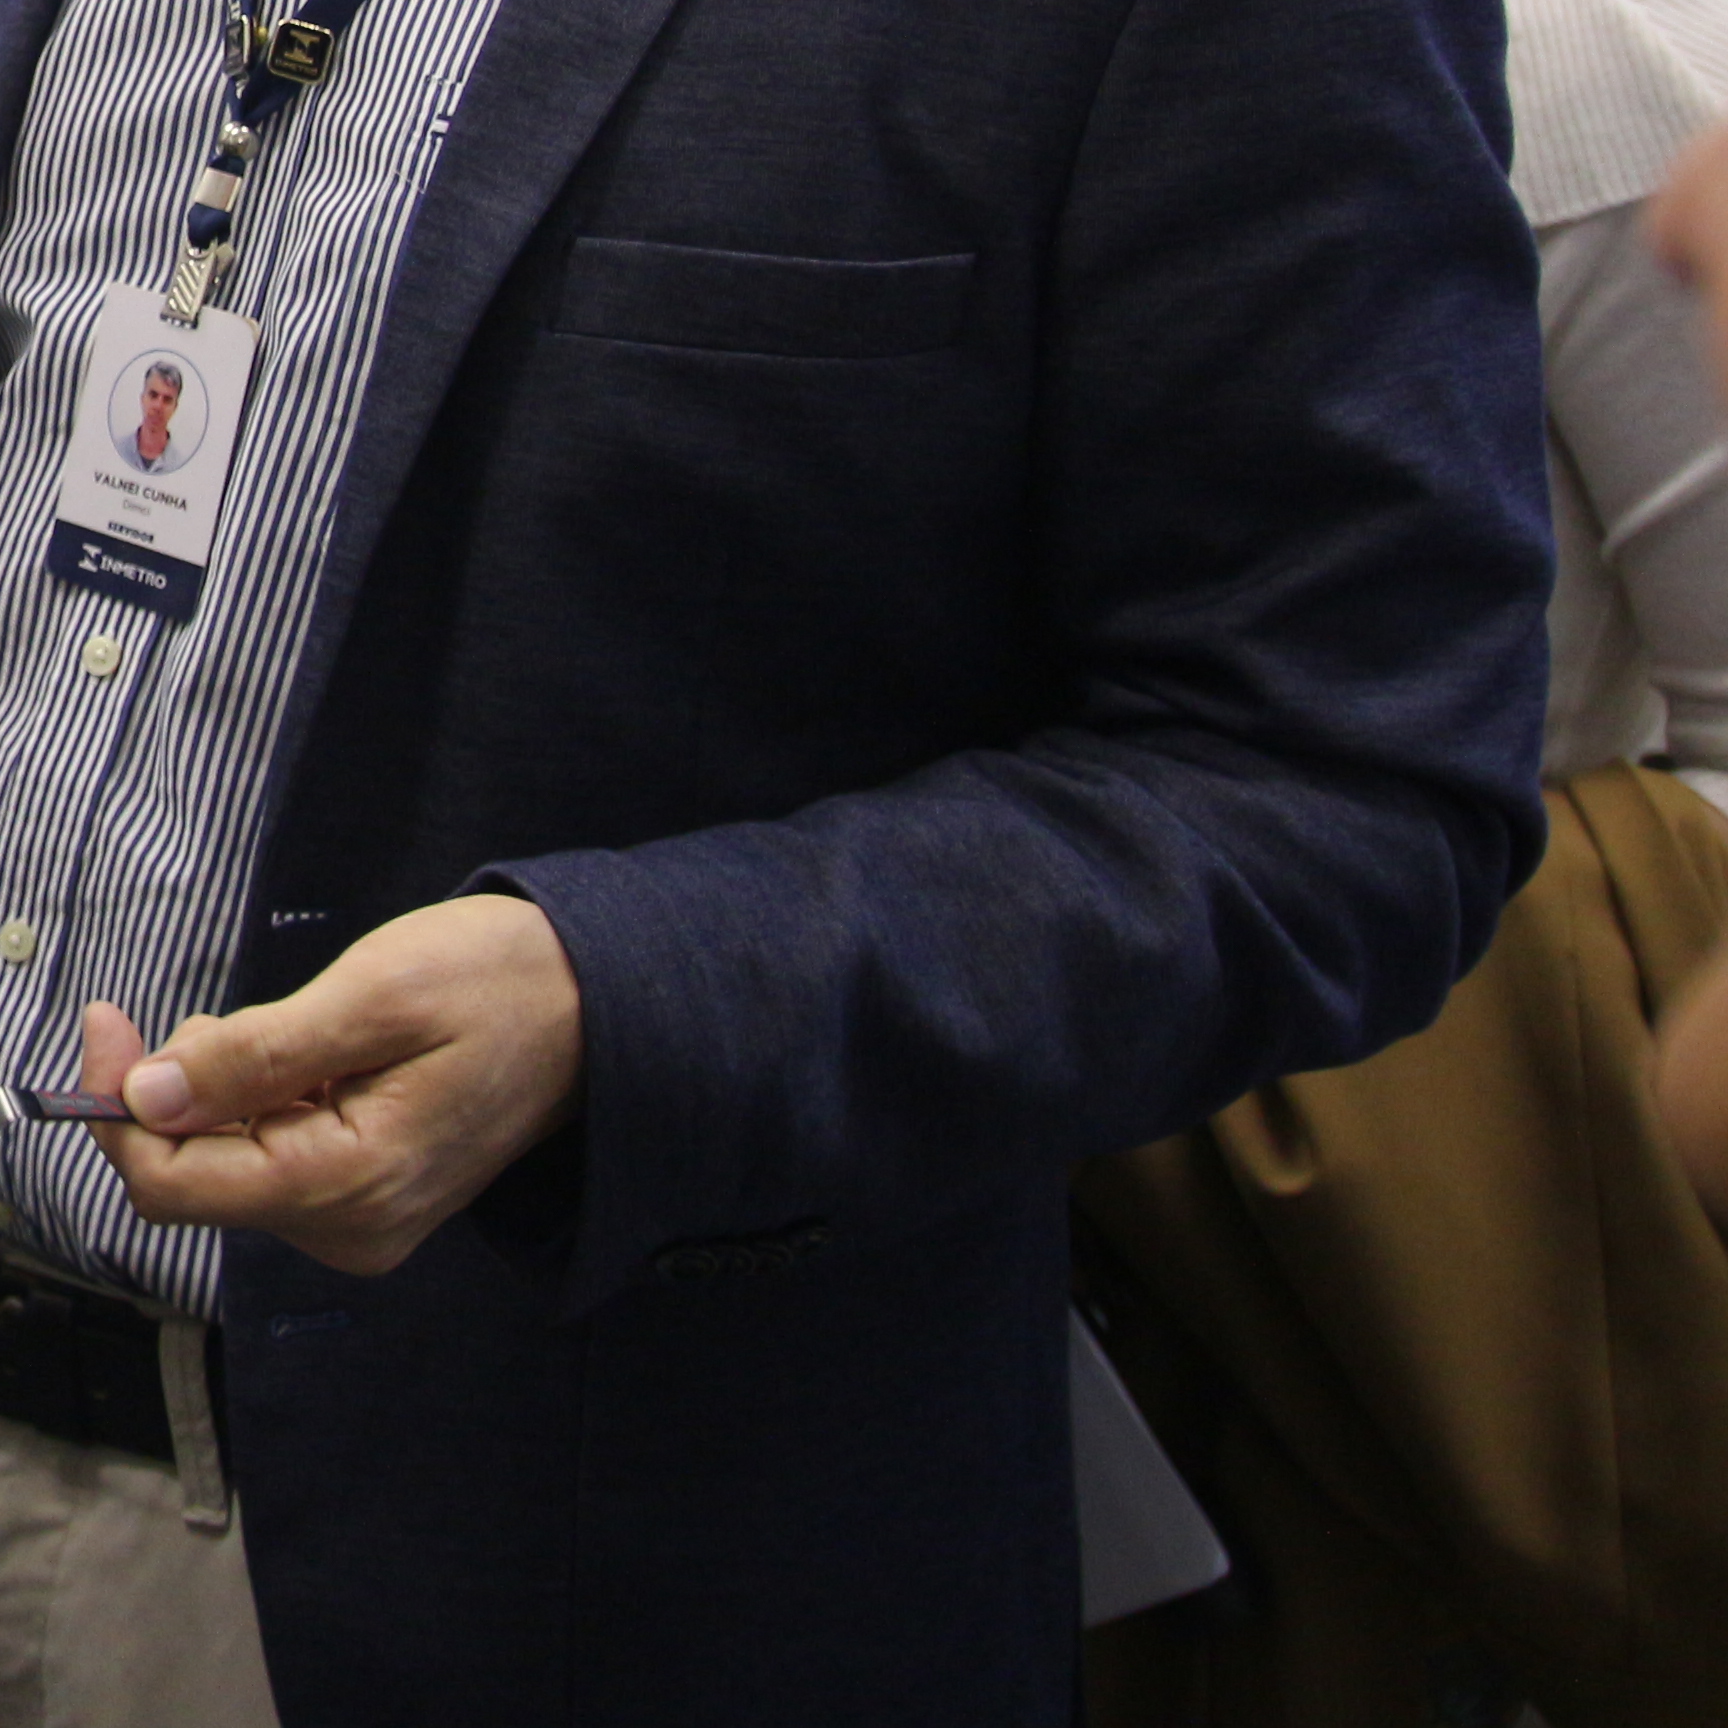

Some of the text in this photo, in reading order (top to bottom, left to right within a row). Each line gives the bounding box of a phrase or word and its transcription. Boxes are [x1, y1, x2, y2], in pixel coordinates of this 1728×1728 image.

[93, 471, 188, 512] VALNEI CUNHA
[99, 554, 168, 590] INMETRO
